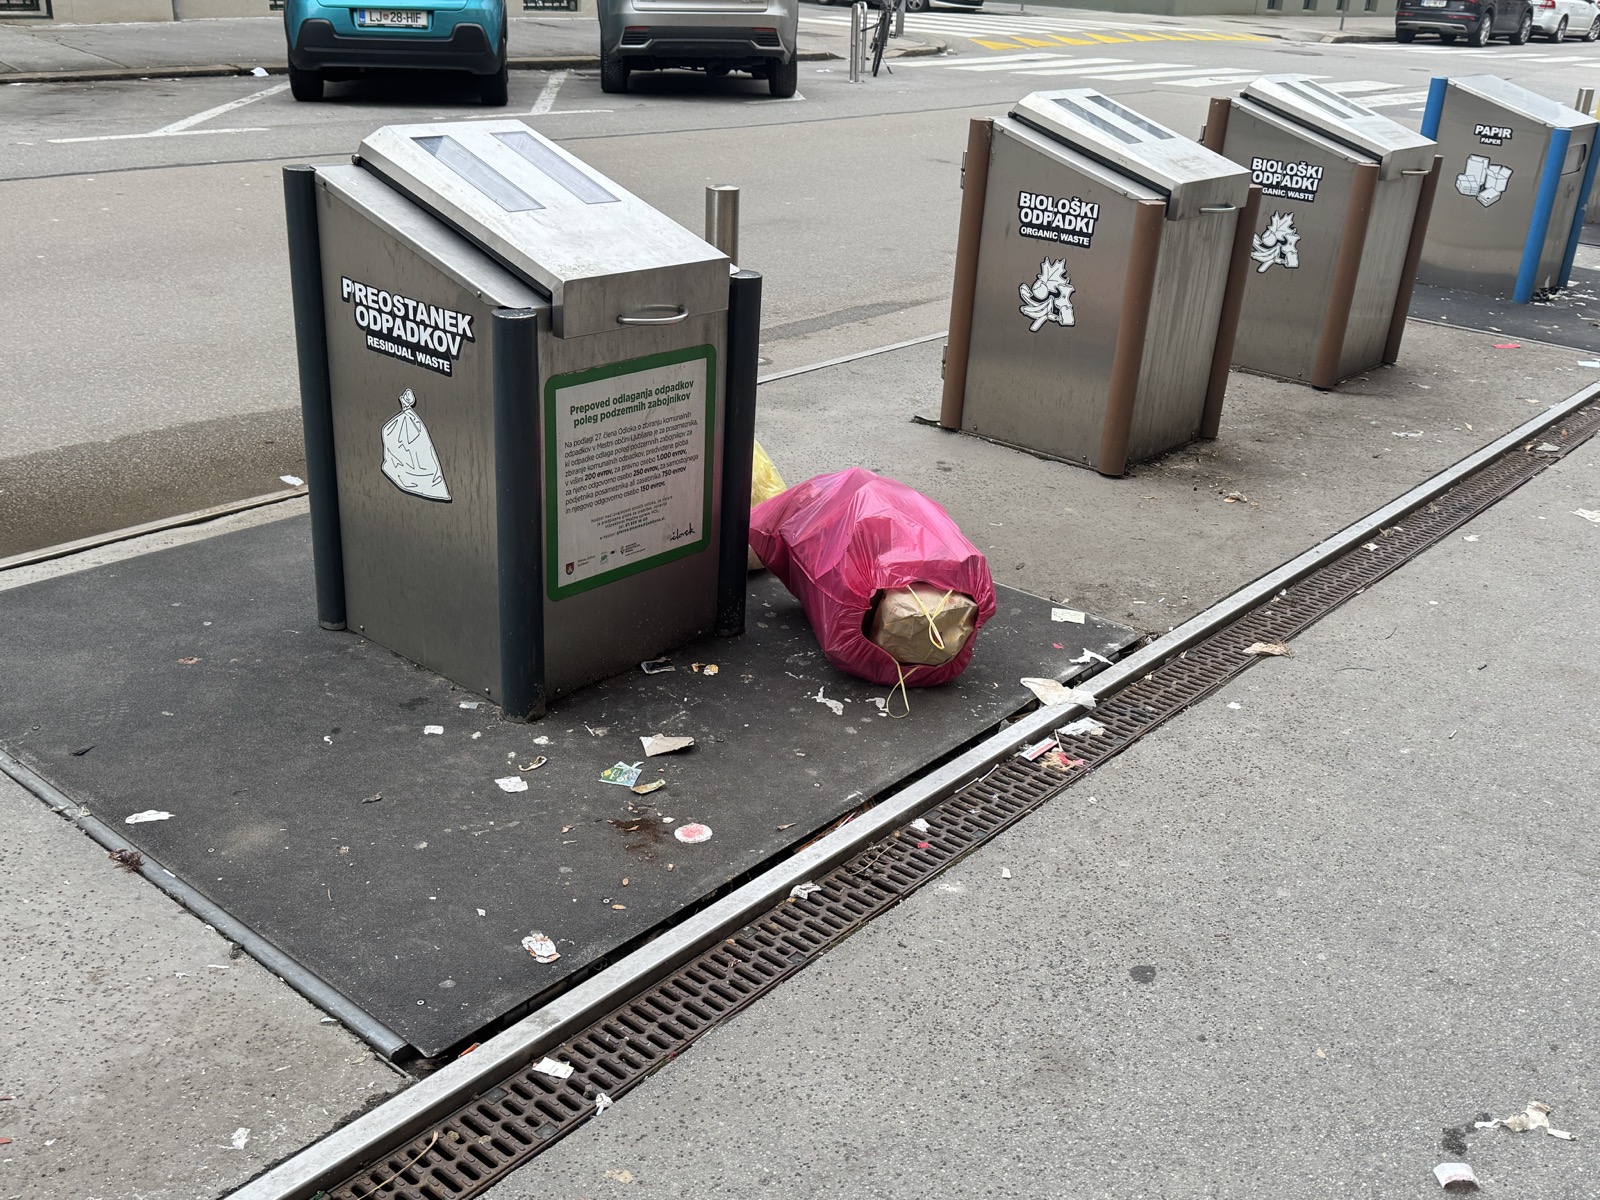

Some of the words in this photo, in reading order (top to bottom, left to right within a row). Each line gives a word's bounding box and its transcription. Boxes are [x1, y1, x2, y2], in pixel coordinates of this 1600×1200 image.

[370, 11, 383, 22] LJ
[390, 12, 422, 23] 28-HIF
[1474, 124, 1512, 139] PAPIR
[1480, 137, 1502, 145] PAPER
[1251, 158, 1323, 179] BIOLOŠKI
[1252, 171, 1318, 191] ODPADKI
[1019, 192, 1100, 219] BIOLOŠKI
[1262, 188, 1286, 197] GANIC
[1287, 191, 1315, 201] WASTE
[1020, 208, 1095, 234] ODPADKI
[1020, 226, 1059, 240] ORGANIC
[1060, 232, 1090, 246] WASTE
[342, 277, 473, 338] PREOSTANEK
[355, 305, 461, 356] ODPADKOV
[367, 335, 414, 361] RESIDUAL
[416, 351, 450, 372] WASTE
[570, 397, 610, 415] Prepoved
[613, 389, 652, 405] odlaganja
[655, 381, 693, 395] odpadkov
[574, 415, 598, 428] poleg
[600, 402, 645, 422] podzemnih
[648, 393, 690, 408] zabojnikov
[565, 447, 591, 458] odpadkov
[597, 441, 613, 449] Mestni
[615, 436, 630, 445] občini
[631, 431, 653, 441] Ljubljana
[666, 420, 698, 432] posameznika,
[574, 435, 594, 447] podlagi
[603, 430, 617, 439] člena
[618, 425, 636, 435] Odloka
[642, 420, 662, 429] zbiranju
[663, 412, 691, 423] komunalnih
[565, 467, 586, 477] zbiranje
[588, 458, 617, 470] komunalnih
[619, 452, 645, 462] odpadkov,
[646, 444, 673, 456] predvidena
[675, 440, 688, 449] globa
[571, 455, 594, 466] odpadke
[596, 450, 613, 459] odlaga
[615, 446, 629, 455] poleg
[631, 438, 658, 451] podzemnih
[660, 432, 685, 443] zabojnikov
[570, 477, 583, 485] višini
[585, 472, 596, 481] 200
[597, 469, 613, 477] evrov,
[622, 462, 639, 472] pravno
[640, 457, 655, 466] osebo
[657, 452, 671, 461] 1.000
[672, 449, 687, 457] evrov,
[573, 485, 587, 494] njeno
[588, 477, 616, 489] odgovorno
[617, 473, 632, 481] osebo
[633, 468, 643, 477] 250
[667, 455, 698, 467] samostojnega
[566, 493, 593, 505] podjetnika
[595, 483, 628, 497] posameznika
[637, 473, 661, 485] zasebnika
[662, 469, 671, 477] 750
[672, 466, 686, 474] evrov
[572, 502, 593, 512] njegovo
[594, 493, 623, 506] odgovorno
[624, 489, 639, 497] osebo
[640, 484, 650, 492] 150
[650, 481, 665, 489] evrov.
